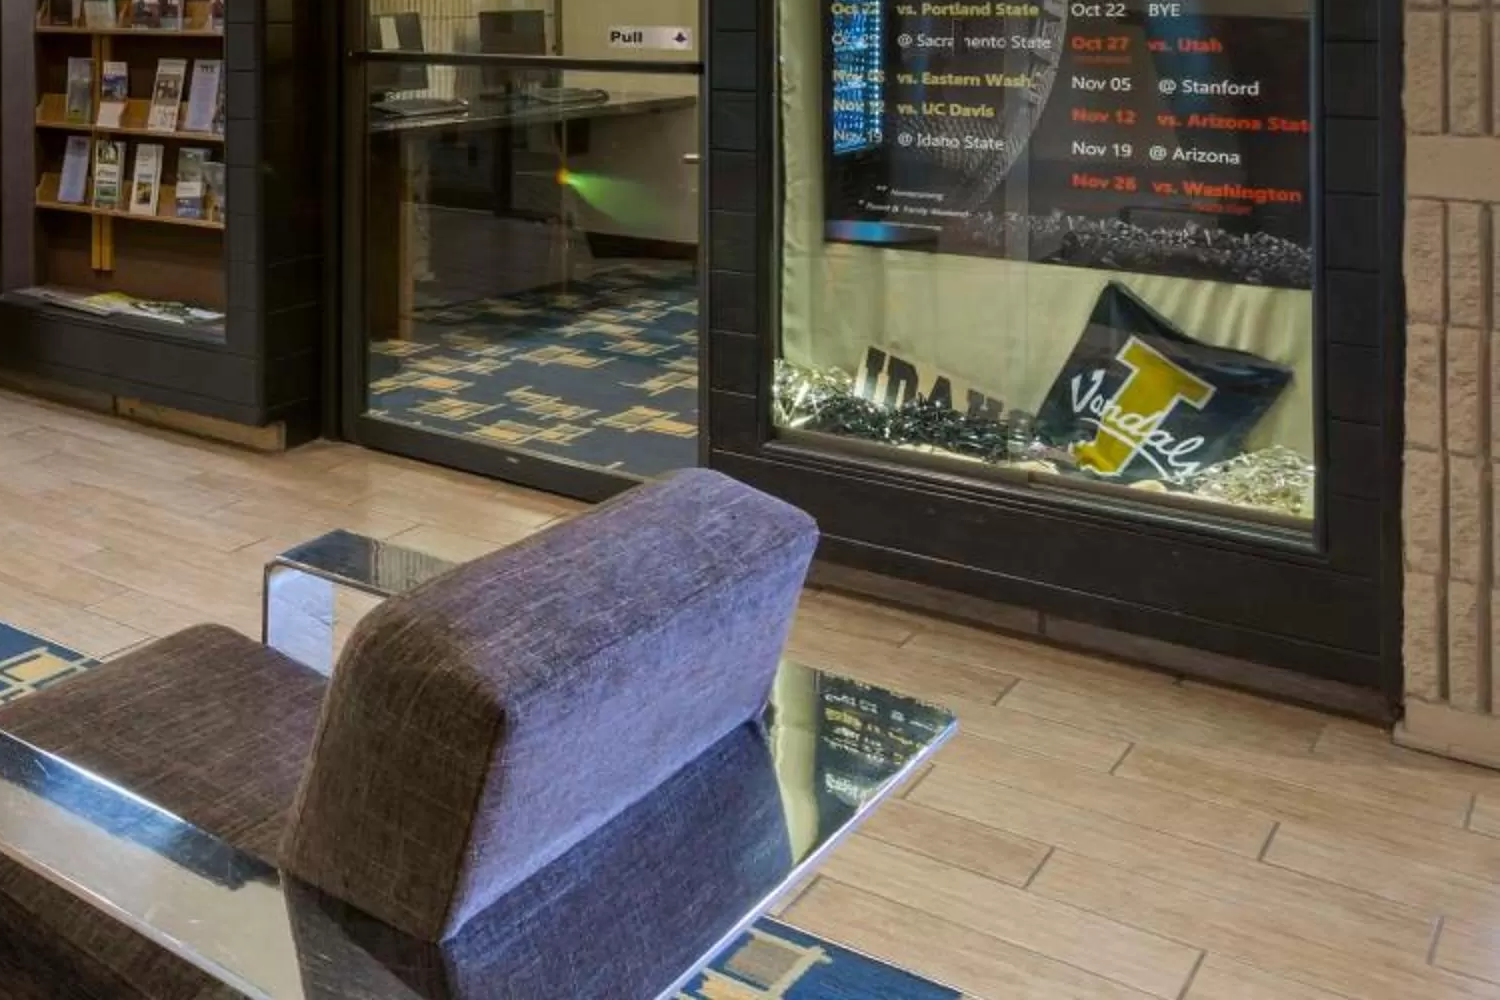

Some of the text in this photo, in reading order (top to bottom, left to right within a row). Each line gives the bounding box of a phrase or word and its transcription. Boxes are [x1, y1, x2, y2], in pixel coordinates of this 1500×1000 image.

[896, 4, 917, 16] vs.
[921, 1, 992, 17] Portland
[995, 3, 1040, 17] State
[1070, 3, 1181, 17] Oct 22 BYE
[610, 30, 643, 44] Pull
[897, 33, 913, 48] @
[1011, 35, 1052, 49] State
[1071, 36, 1102, 51] Oct
[1177, 37, 1223, 52] Utah
[922, 71, 981, 86] Eastern
[1071, 76, 1260, 96] Nov 05 @ Stanford
[921, 102, 946, 116] UC
[950, 103, 996, 118] Davis
[1071, 107, 1109, 123] Nov
[1115, 109, 1137, 125] 12
[1188, 113, 1262, 131] Arizona
[898, 131, 913, 147] @
[916, 132, 961, 148] Idaho
[964, 135, 1004, 151] State
[1071, 140, 1241, 165] Nov 19 @ Arizona
[1071, 173, 1110, 190] Nov
[1114, 175, 1137, 191] 26
[1183, 180, 1303, 204] Washington
